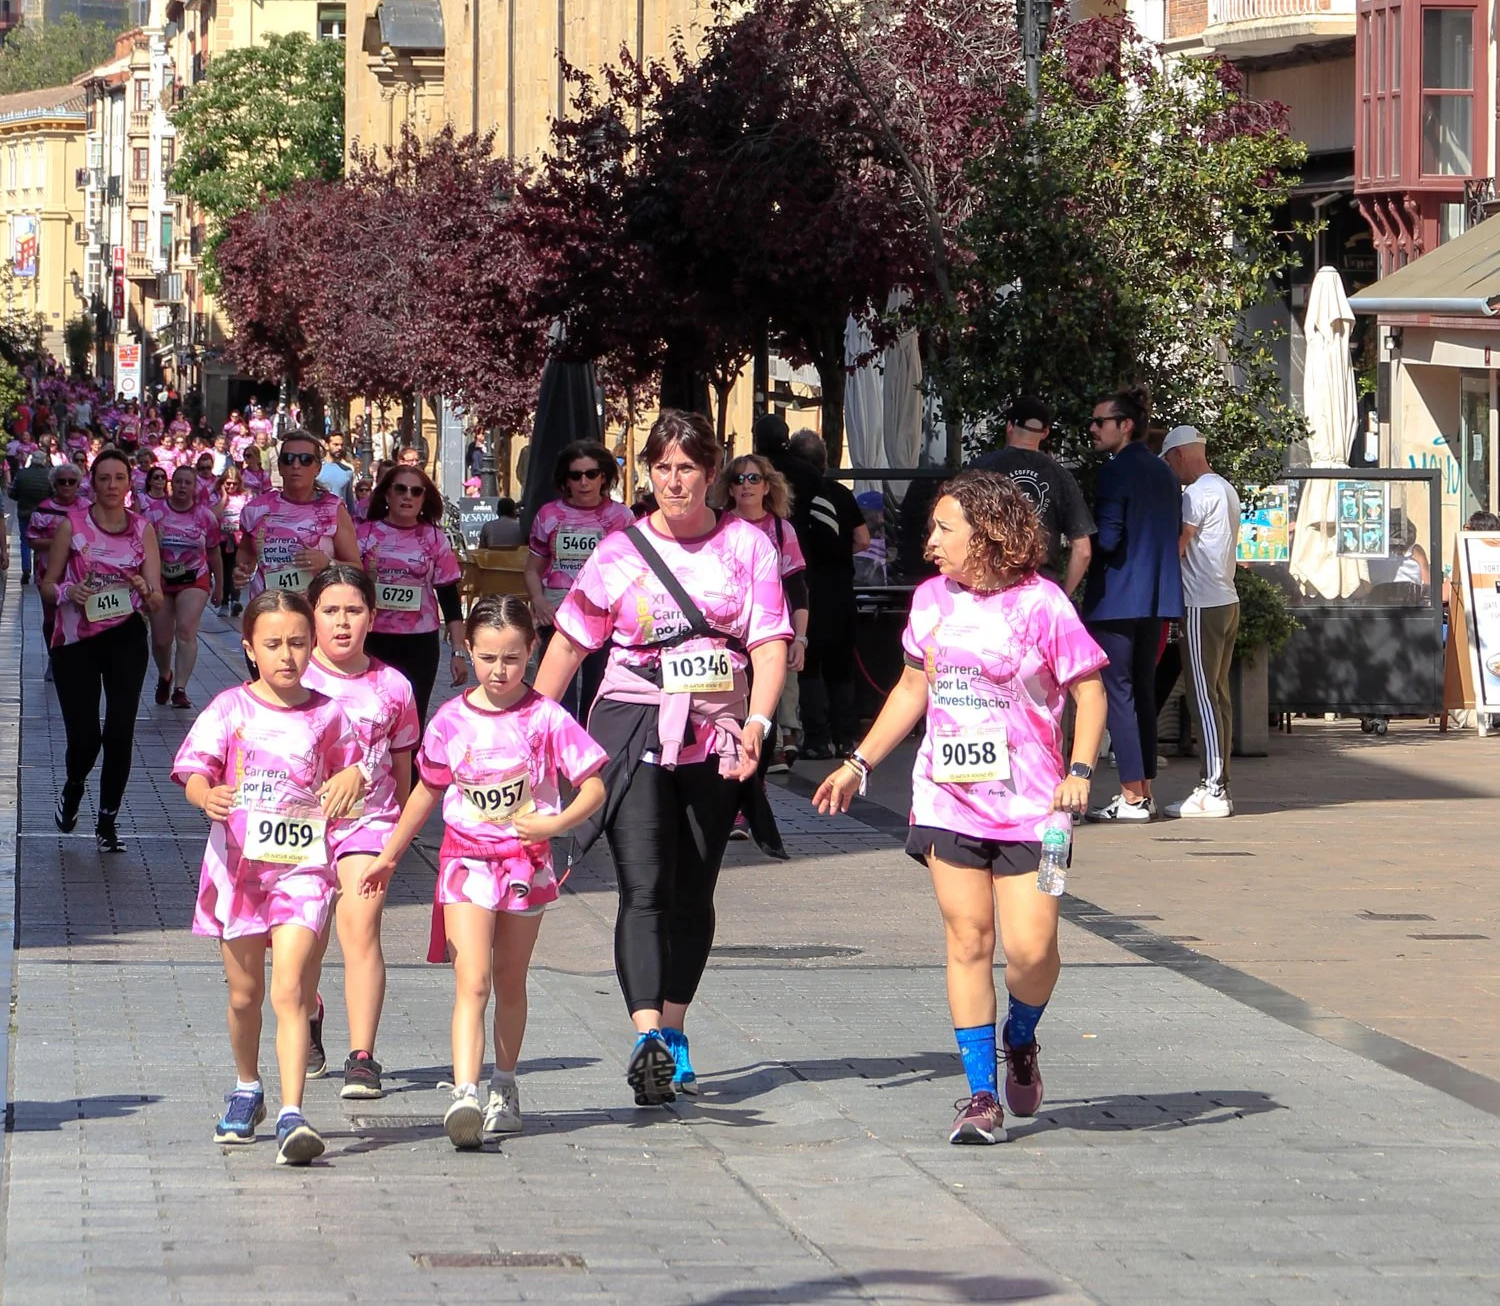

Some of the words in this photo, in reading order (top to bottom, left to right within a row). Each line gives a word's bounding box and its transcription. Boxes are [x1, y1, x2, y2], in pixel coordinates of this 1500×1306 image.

[1014, 469, 1040, 479] COFFEE
[264, 536, 297, 544] Carrera
[562, 536, 597, 550] 5466
[263, 546, 277, 555] por
[278, 545, 287, 553] la
[278, 572, 300, 588] 411
[97, 594, 120, 611] 414
[382, 587, 414, 603] 6729
[651, 593, 666, 605] XI
[937, 647, 948, 658] XI
[668, 653, 728, 677] 10346
[935, 662, 980, 677] Carrera
[937, 680, 954, 693] por
[956, 678, 969, 691] la
[246, 749, 256, 762] XI
[942, 741, 998, 767] 9058
[243, 765, 288, 780] Carrera
[243, 782, 259, 794] por
[261, 781, 273, 794] la
[258, 819, 314, 848] 9059
